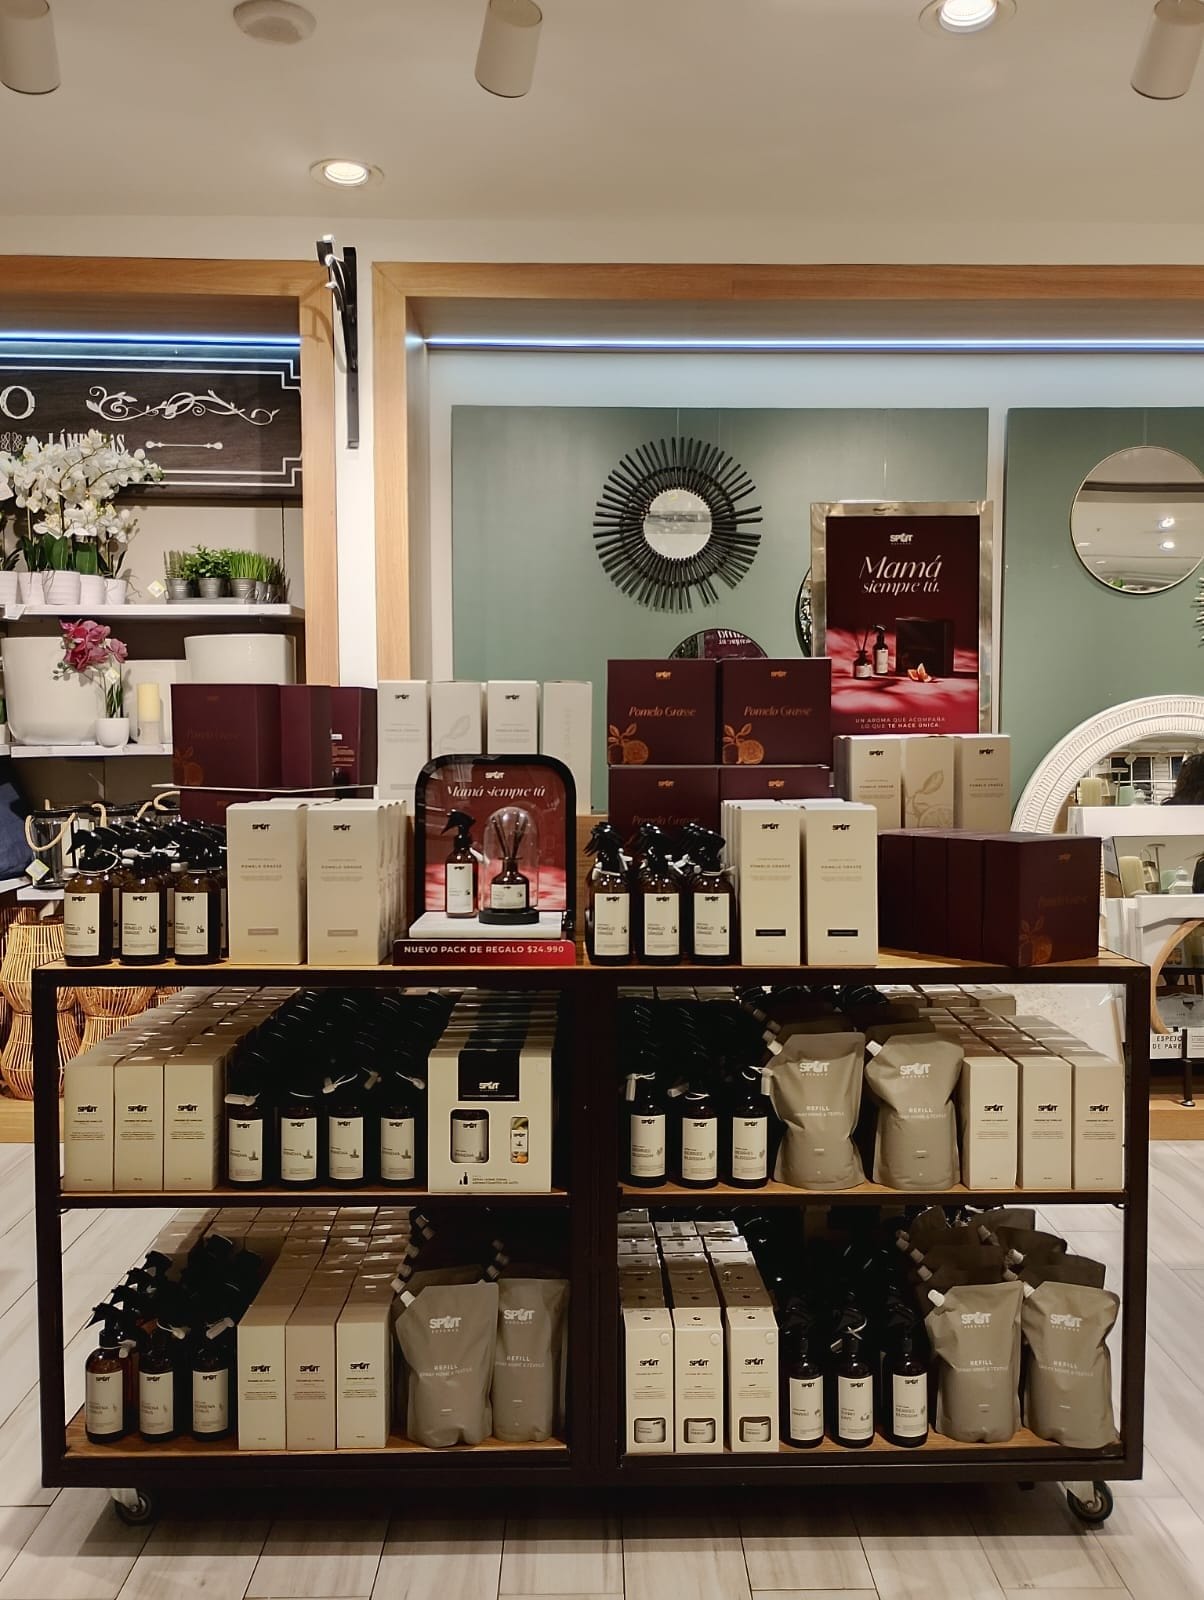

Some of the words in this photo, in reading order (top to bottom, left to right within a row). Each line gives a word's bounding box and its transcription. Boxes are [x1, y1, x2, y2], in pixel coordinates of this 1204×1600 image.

[859, 555, 942, 579] Mamá
[863, 580, 920, 596] siempre
[628, 706, 663, 717] Pomelo
[743, 706, 779, 717] Pomelo
[447, 785, 483, 797] Mamá
[486, 787, 530, 800] siempre
[533, 785, 546, 797] tú
[527, 945, 564, 953] $24.990
[1054, 1360, 1078, 1369] REFILL
